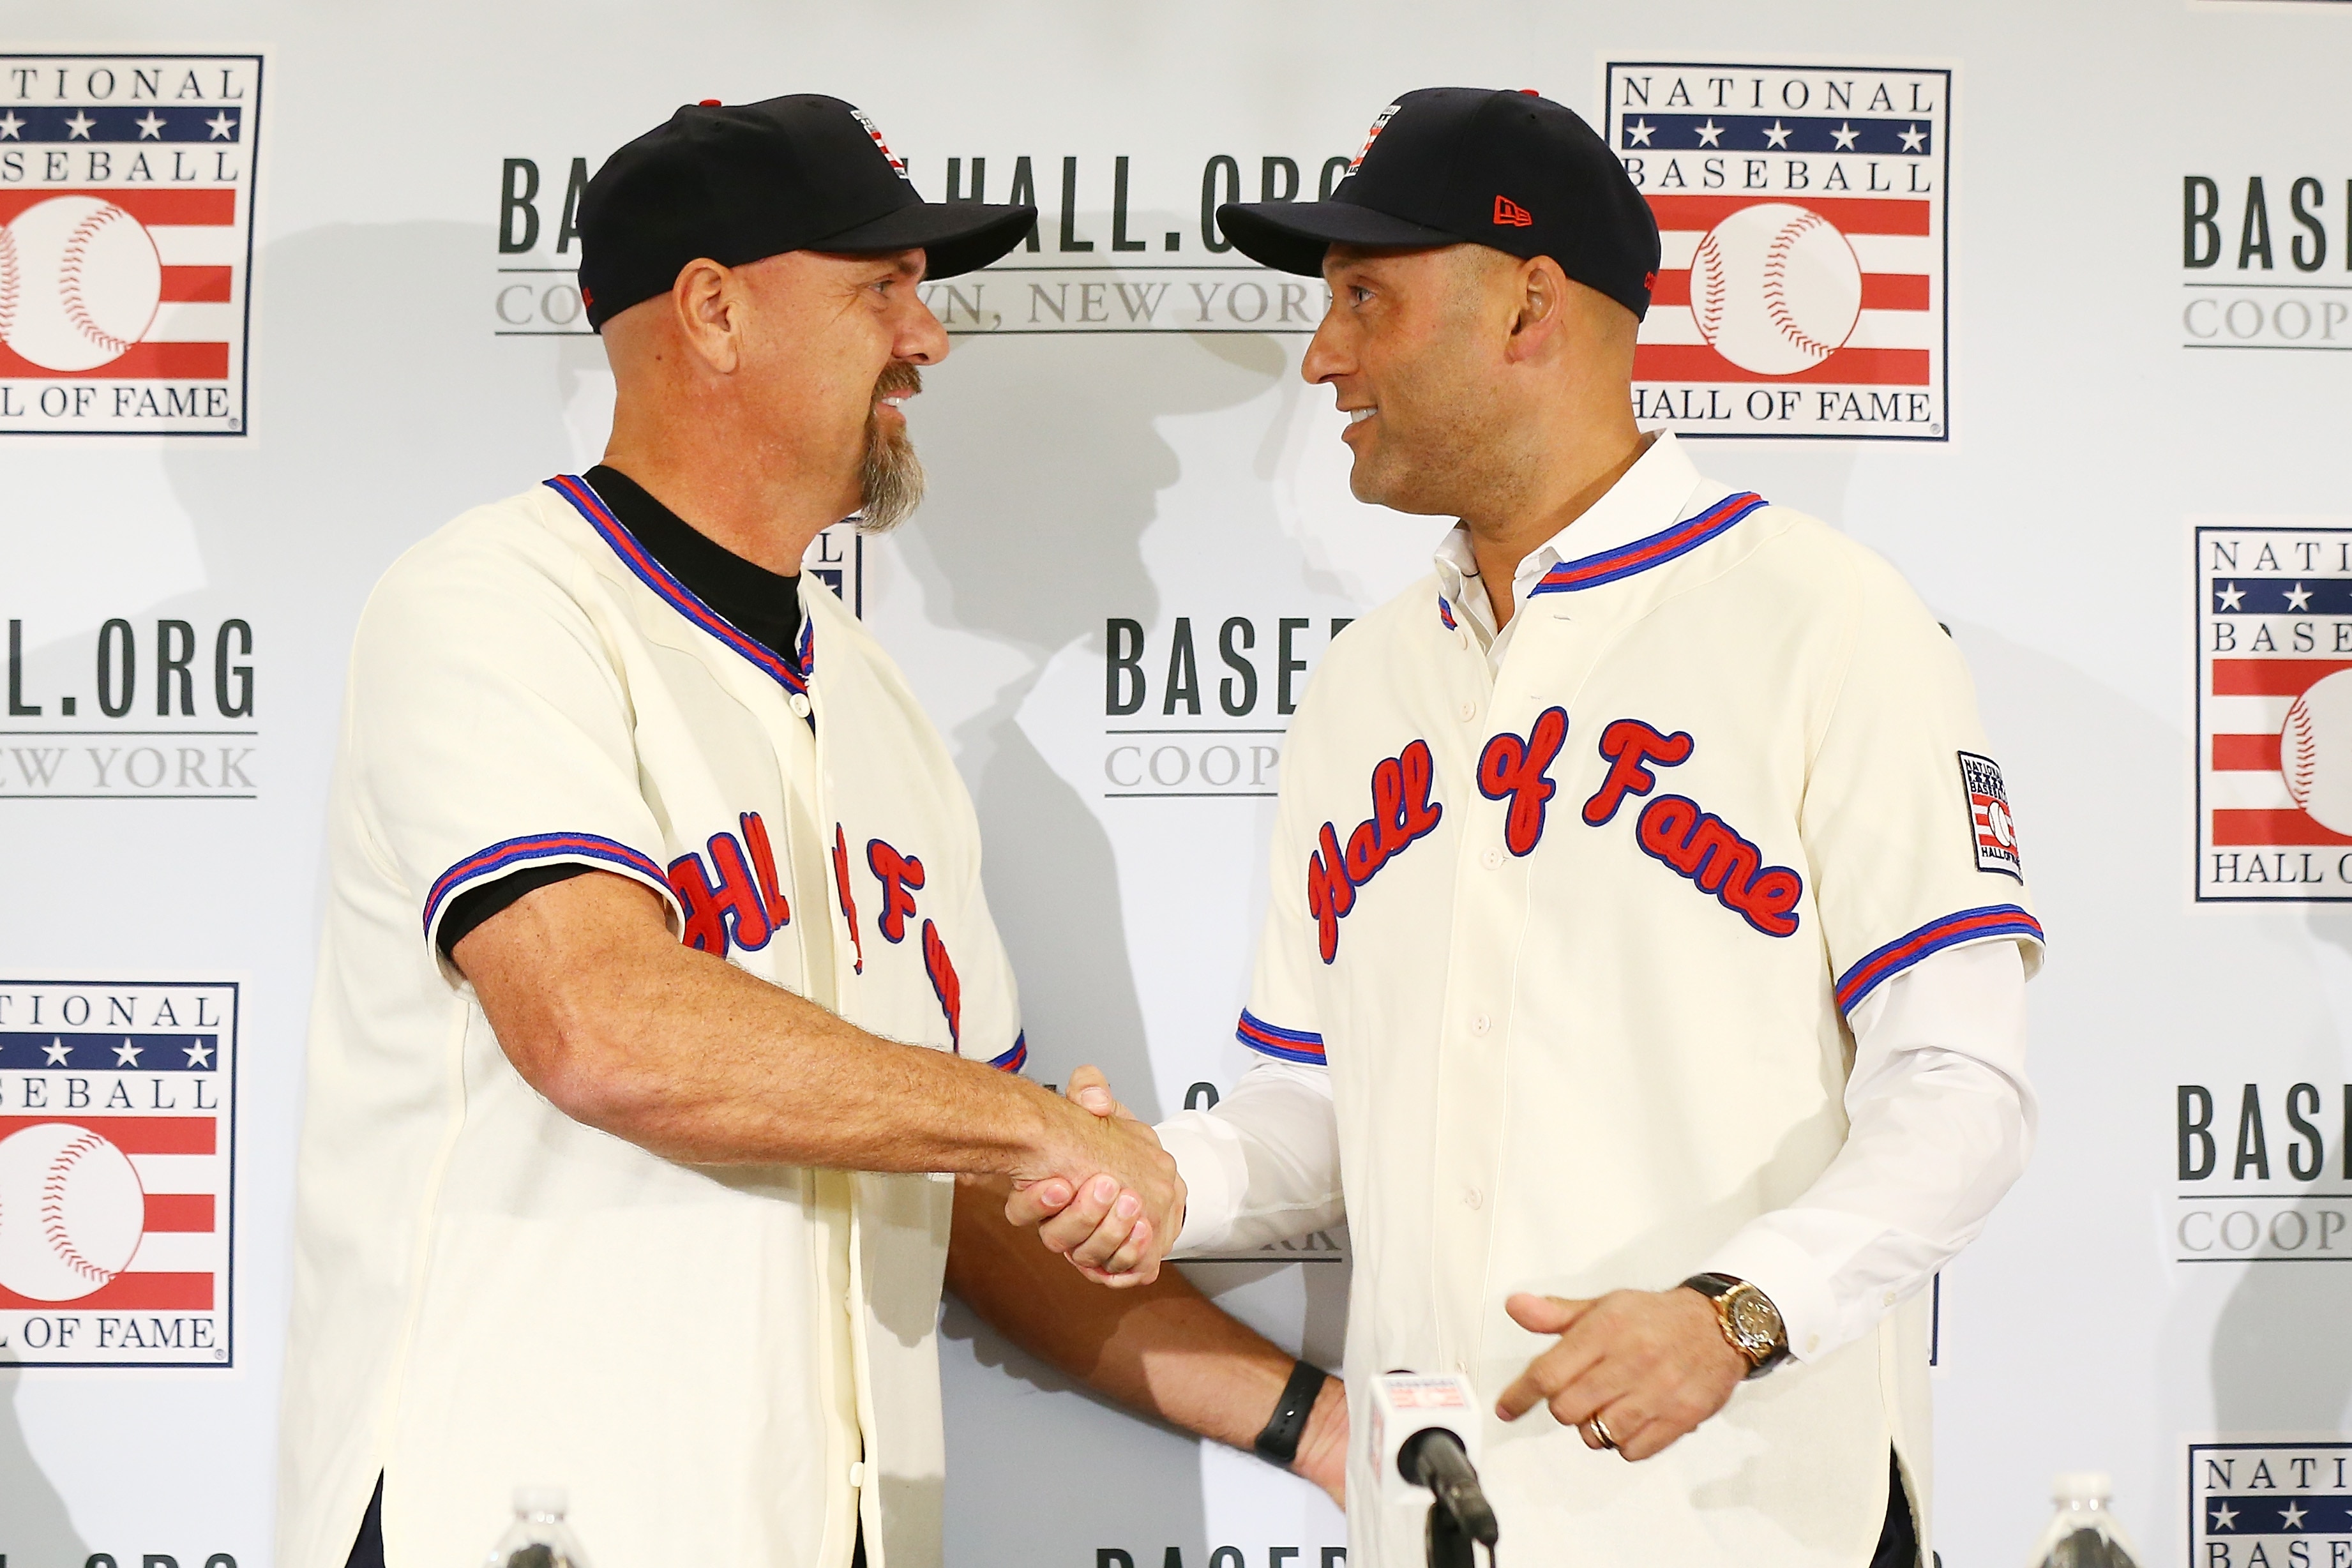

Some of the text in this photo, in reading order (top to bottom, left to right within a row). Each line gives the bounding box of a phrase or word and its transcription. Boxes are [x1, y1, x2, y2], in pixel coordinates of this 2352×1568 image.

[1623, 77, 1933, 112] NATIONAL
[2183, 176, 2352, 272] BAS
[1028, 282, 1170, 324] NEW
[1189, 282, 1332, 324] YOR
[2183, 299, 2349, 340] COOP
[41, 387, 96, 417] OF
[112, 388, 229, 418] FAME
[1746, 391, 1801, 420] OF
[1816, 392, 1931, 422] FAME
[85, 747, 257, 788] YORK
[1308, 706, 1802, 965] Hall of Fame
[1982, 847, 2005, 860] HALL
[2211, 854, 2323, 883] HALL
[2178, 1083, 2352, 1181] BAS
[24, 1317, 215, 1348] OF FAME
[2205, 1458, 2347, 1489] NATI
